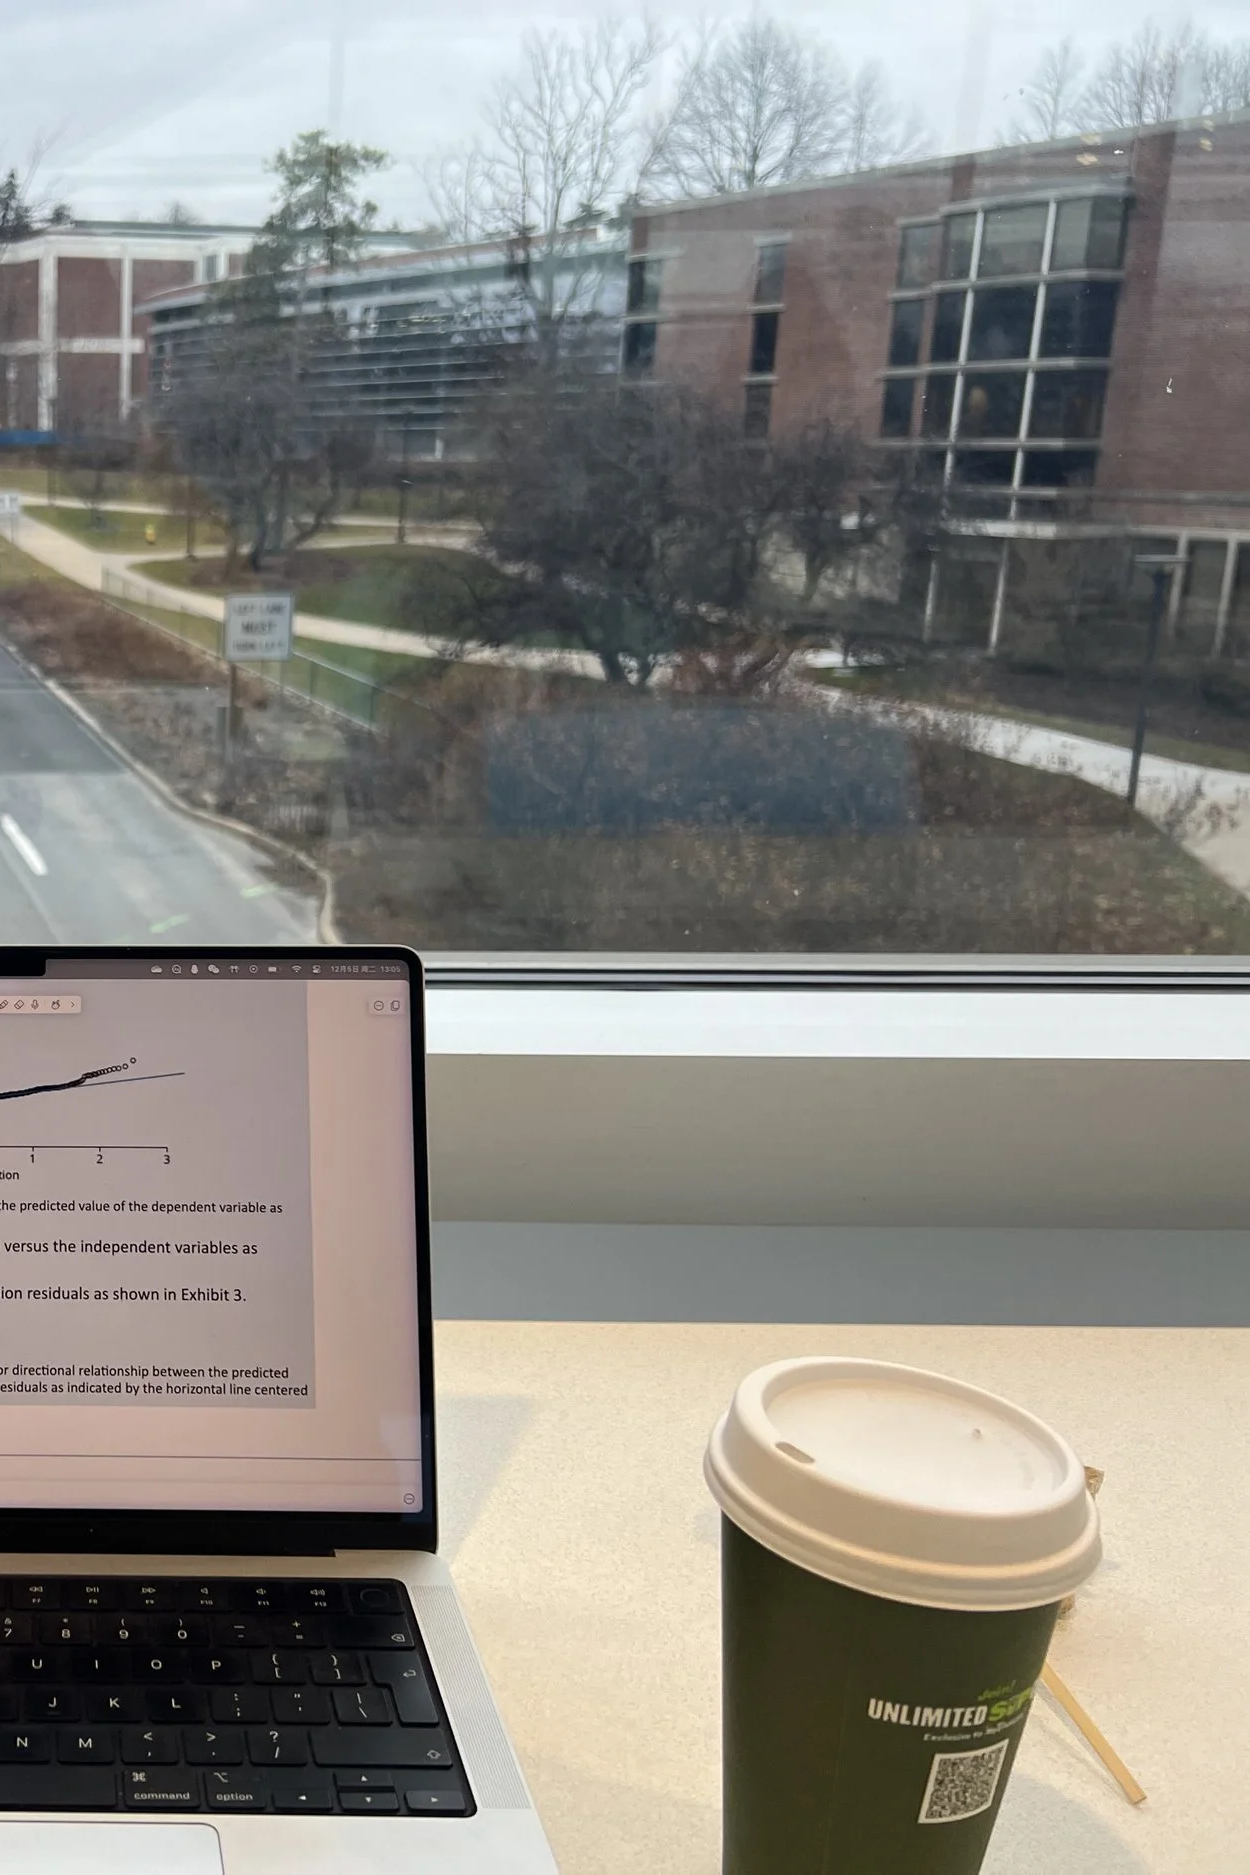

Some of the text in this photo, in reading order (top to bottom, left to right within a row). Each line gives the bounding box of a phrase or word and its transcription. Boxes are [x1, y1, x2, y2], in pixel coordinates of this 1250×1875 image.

[30, 1154, 36, 1164] 1
[96, 1154, 103, 1164] 2
[163, 1154, 171, 1165] 3
[19, 1199, 76, 1214] predicted
[78, 1199, 110, 1212] value
[112, 1200, 127, 1212] of
[128, 1200, 149, 1212] the
[151, 1200, 217, 1215] dependent
[218, 1201, 267, 1214] variable
[269, 1204, 283, 1214] as
[3, 1242, 49, 1253] versus
[52, 1239, 77, 1253] the
[80, 1239, 171, 1257] independent
[174, 1240, 239, 1255] variables
[242, 1244, 258, 1255] as
[27, 1286, 90, 1301] residuals
[93, 1289, 109, 1301] as
[112, 1286, 160, 1301] shown
[163, 1287, 177, 1301] in
[181, 1287, 230, 1302] Exhibit
[233, 1288, 247, 1302] 3.
[11, 1363, 76, 1377] directional
[78, 1364, 150, 1380] relationship
[152, 1365, 205, 1378] between
[208, 1365, 229, 1378] the
[231, 1366, 289, 1381] predicted
[50, 1383, 64, 1393] as
[67, 1381, 122, 1394] indicated
[125, 1381, 140, 1397] by
[142, 1381, 163, 1395] the
[165, 1381, 226, 1395] horizontal
[229, 1382, 252, 1396] line
[254, 1384, 308, 1397] centered
[31, 1658, 43, 1670] U
[150, 1659, 162, 1670] O
[211, 1660, 222, 1670] P
[868, 1698, 988, 1728] UNLIMITED
[133, 1790, 190, 1801] command
[216, 1791, 253, 1802] option
